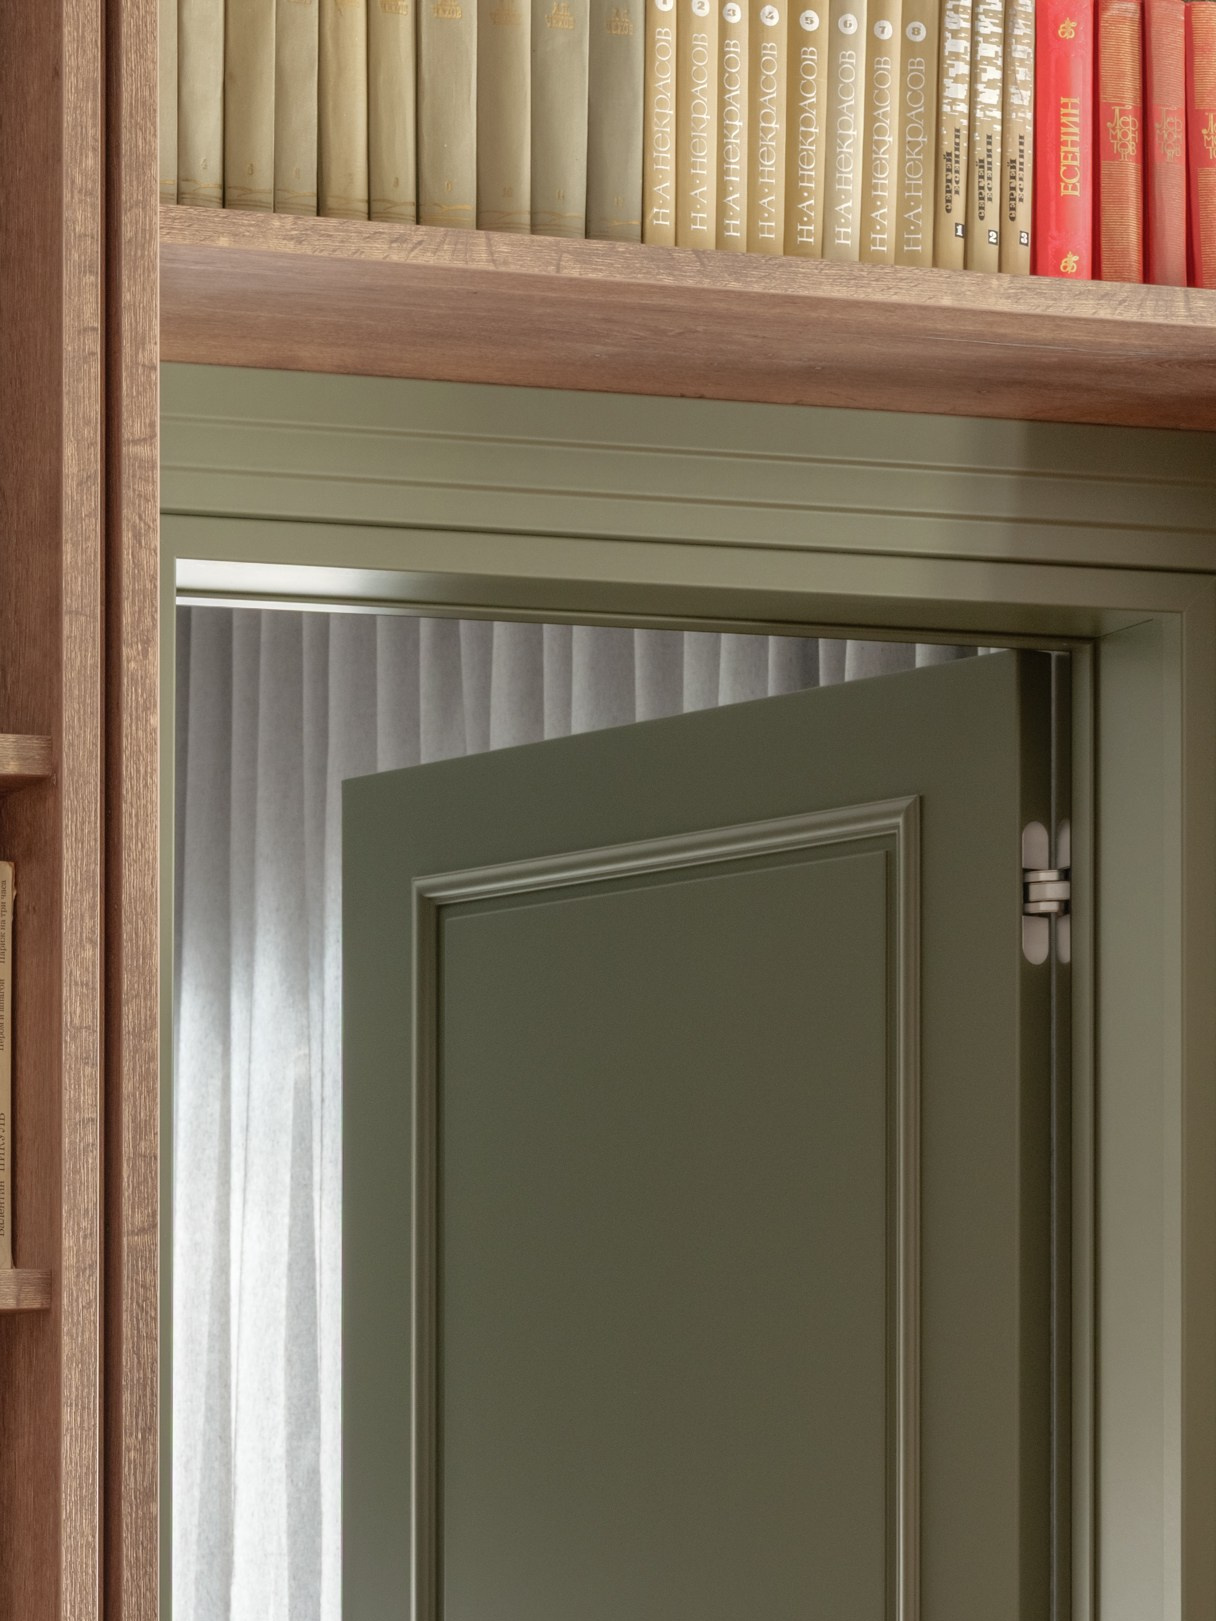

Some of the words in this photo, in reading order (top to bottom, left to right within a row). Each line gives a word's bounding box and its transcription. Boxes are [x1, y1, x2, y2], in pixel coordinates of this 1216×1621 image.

[1059, 96, 1082, 197] ЕСЕНИН
[944, 150, 953, 214] СЕРГЕЙ
[0, 880, 7, 899] часа
[0, 902, 7, 916] три
[0, 920, 6, 931] на
